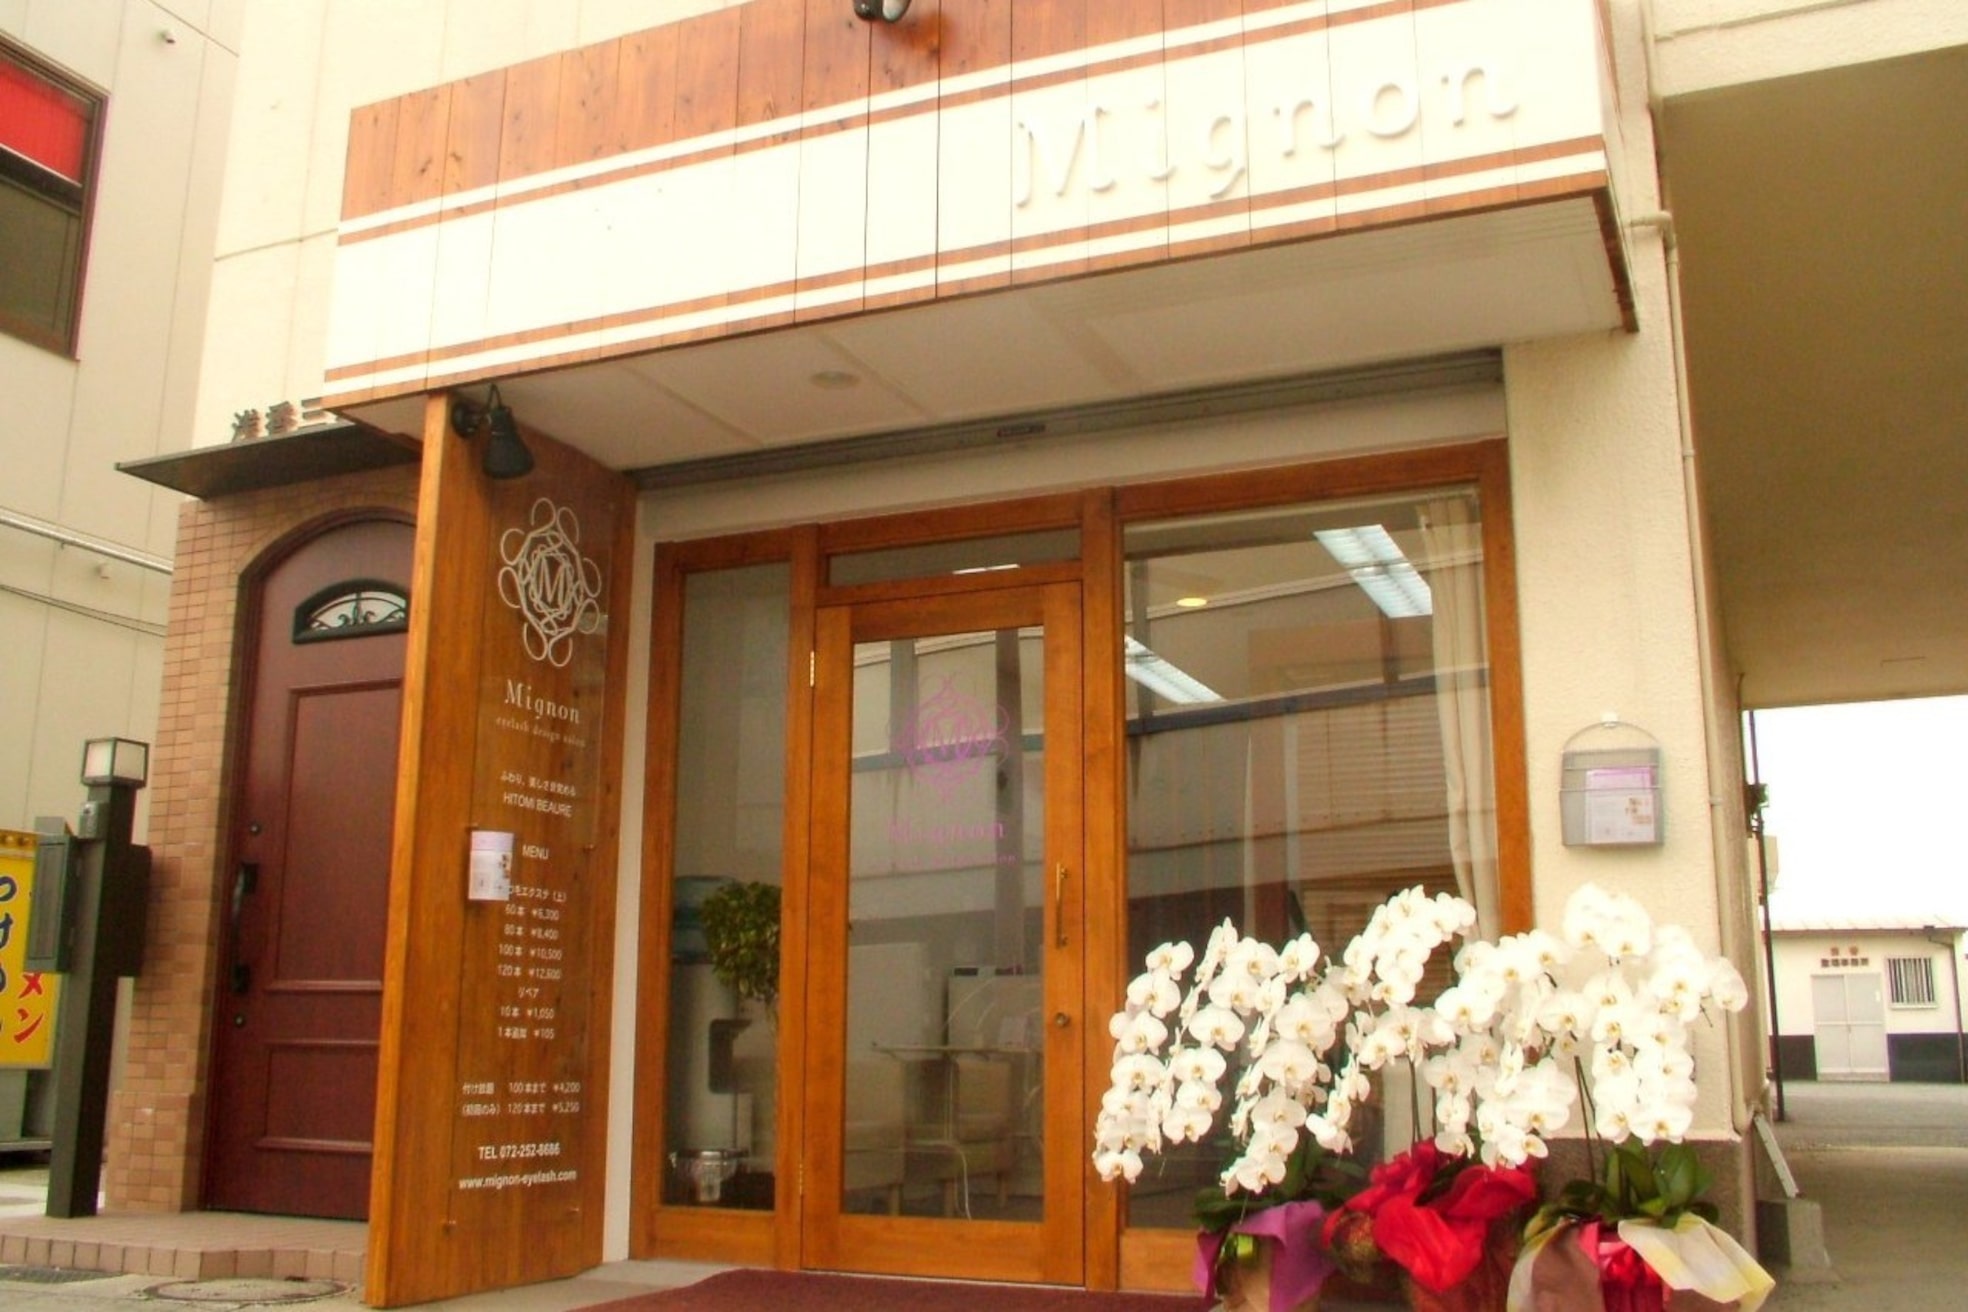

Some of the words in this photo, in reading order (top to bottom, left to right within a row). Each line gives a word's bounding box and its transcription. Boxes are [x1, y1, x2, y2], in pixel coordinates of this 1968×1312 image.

[1012, 62, 1520, 208] Mignon
[505, 678, 580, 724] Mignon
[522, 844, 549, 860] MENU
[478, 1146, 498, 1160] TEL
